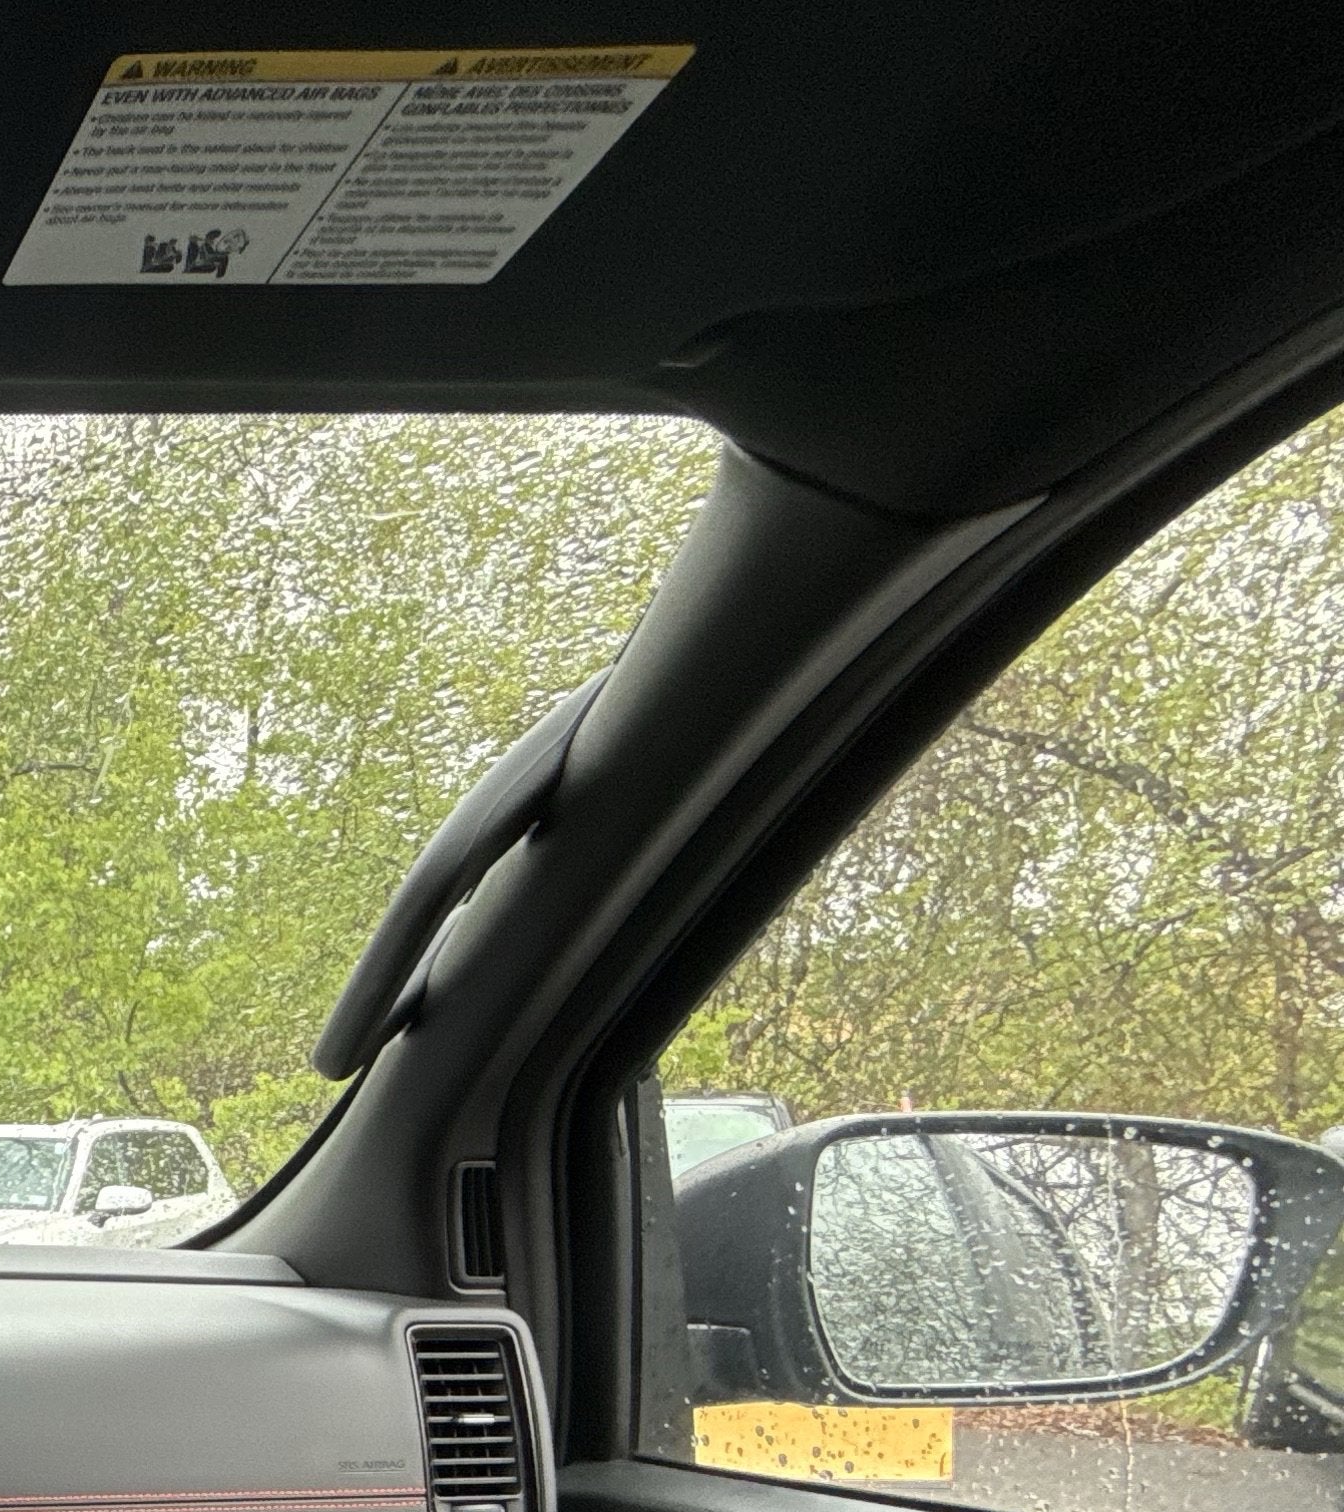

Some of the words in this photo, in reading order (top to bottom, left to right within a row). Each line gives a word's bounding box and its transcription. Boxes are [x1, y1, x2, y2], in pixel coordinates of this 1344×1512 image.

[152, 58, 257, 78] WARNING
[101, 88, 149, 105] EVEN
[151, 87, 198, 103] WITH
[200, 86, 296, 102] ADVANCED
[298, 86, 329, 100] AIR
[330, 85, 382, 99] BAGS
[338, 1461, 359, 1470] SRS
[362, 1460, 406, 1469] AIRBAG
